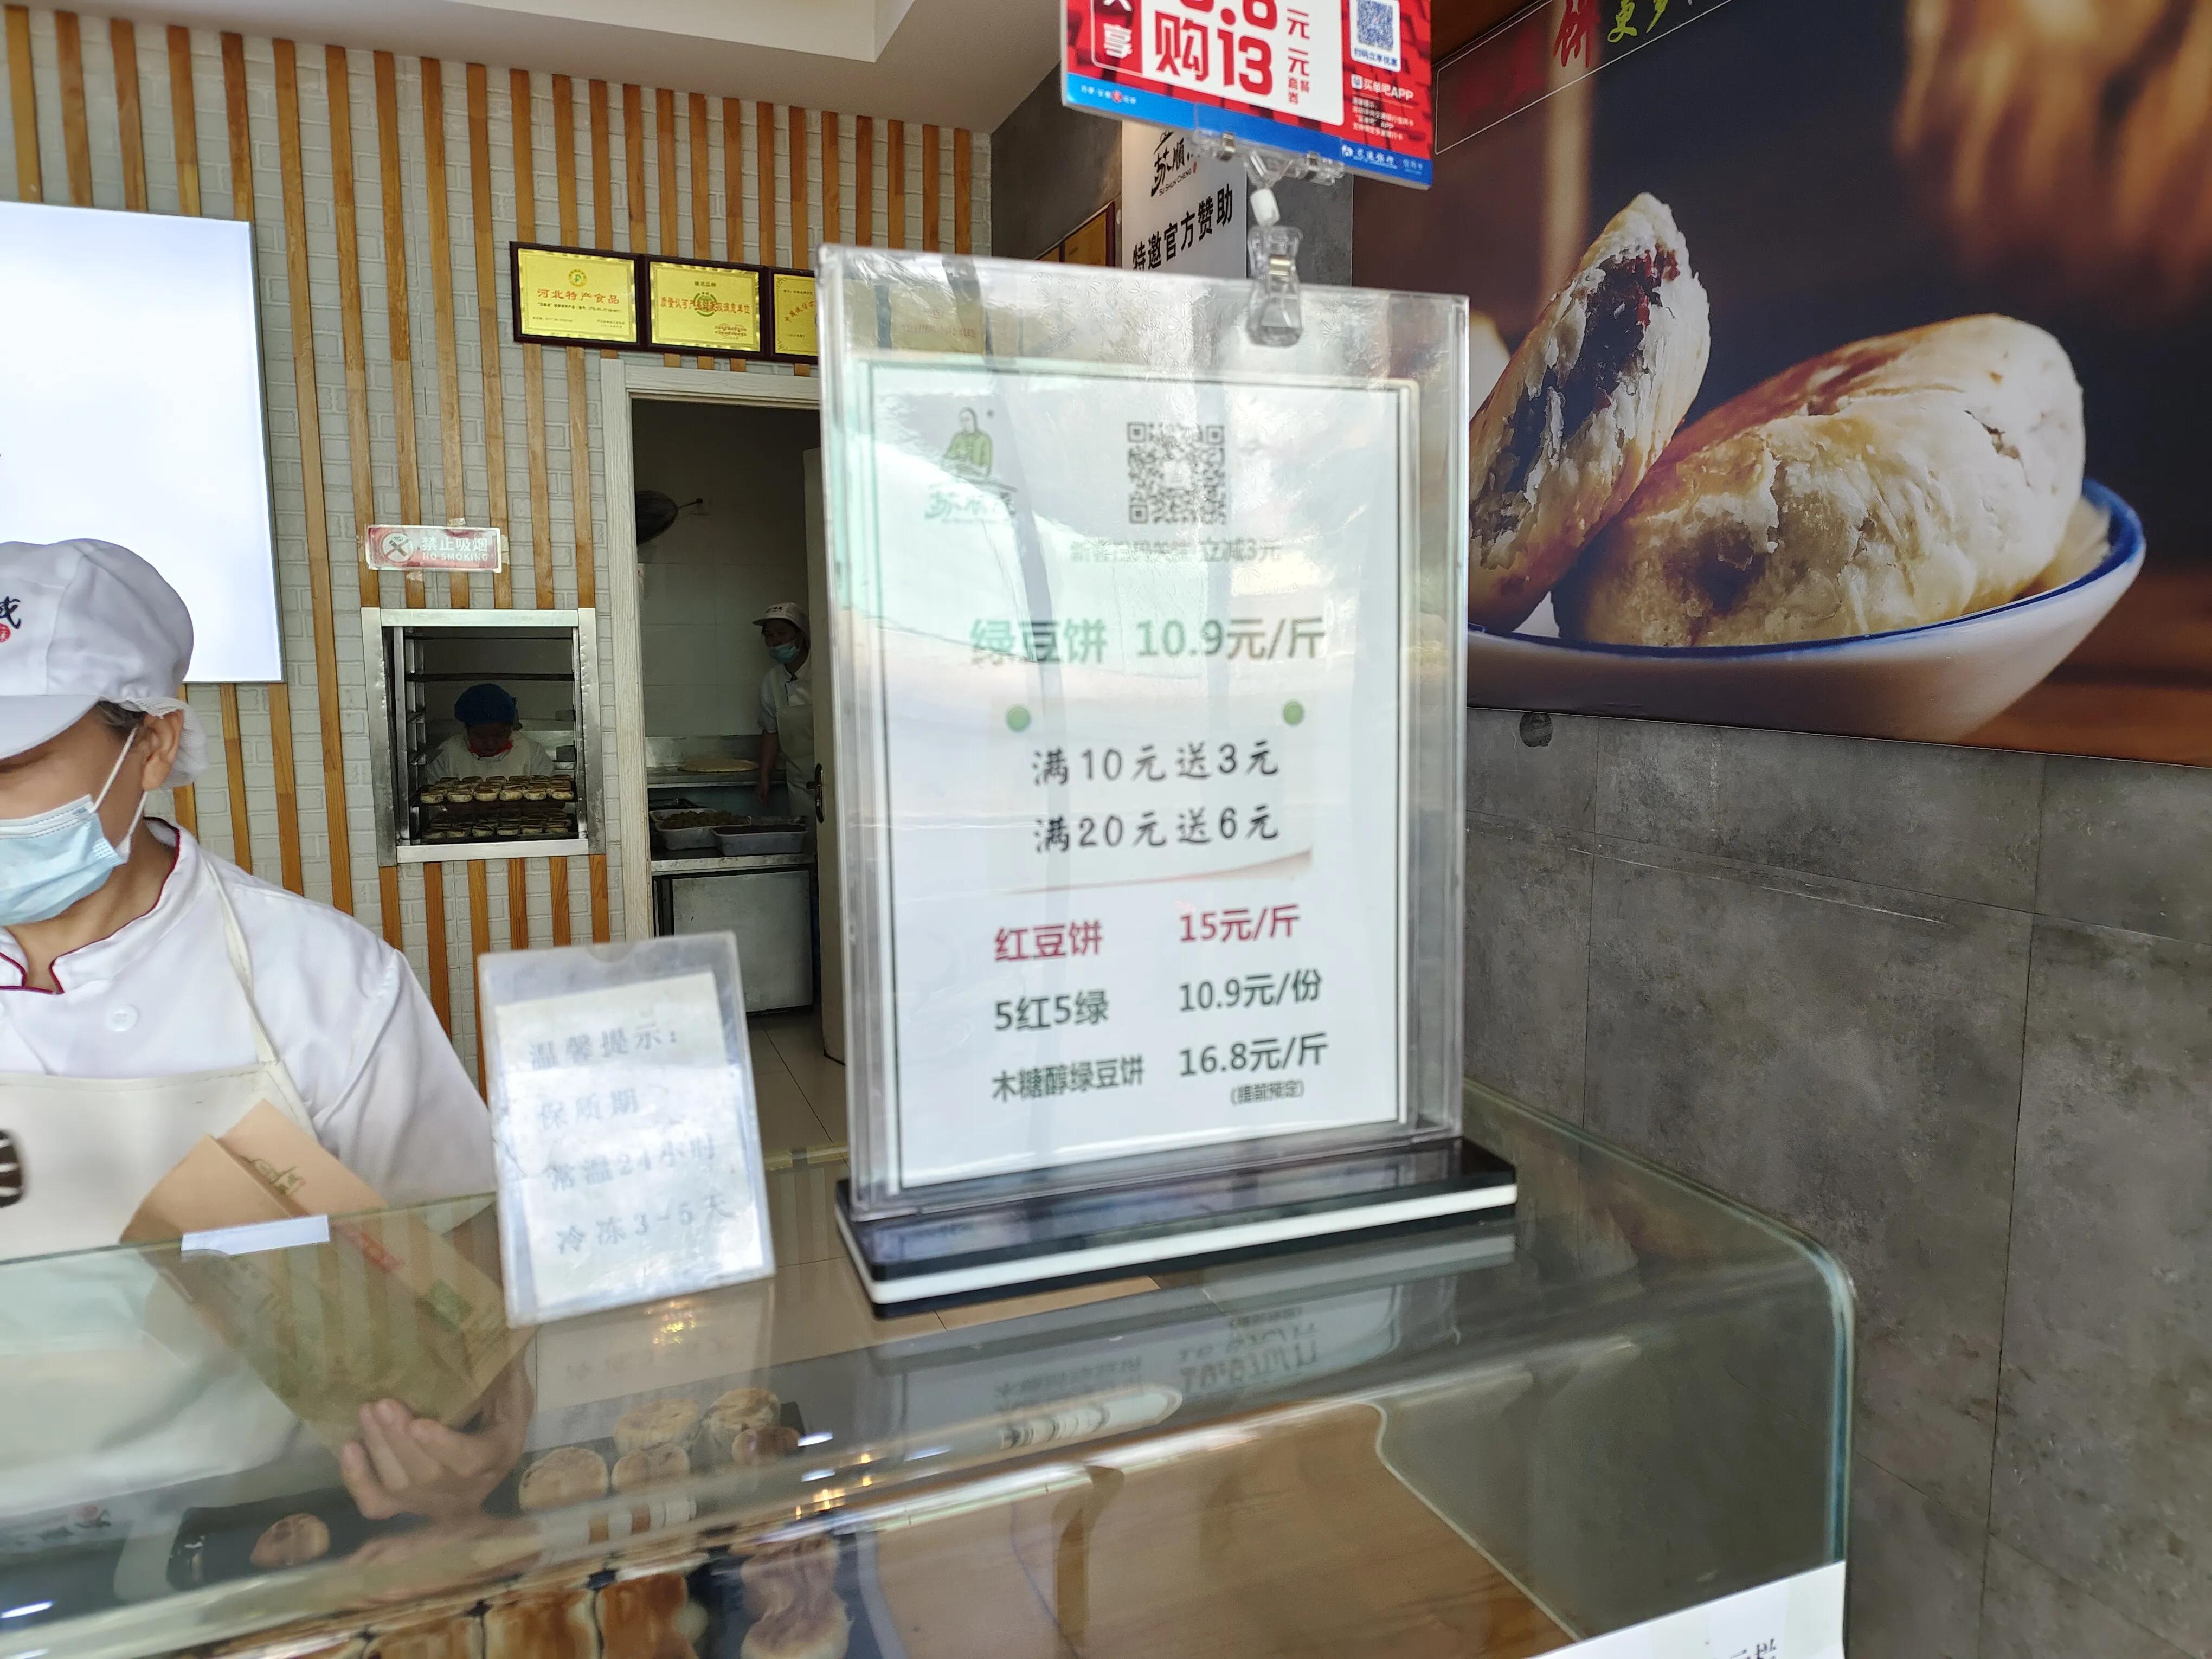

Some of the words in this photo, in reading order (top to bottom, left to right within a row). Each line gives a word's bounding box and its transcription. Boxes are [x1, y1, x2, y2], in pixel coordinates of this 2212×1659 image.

[1363, 78, 1414, 101] 买单吧APP
[1133, 183, 1233, 271] 特邀官方赞助
[537, 288, 620, 305] 河北特产食品
[422, 536, 488, 552] 禁止吸烟
[422, 552, 437, 560] NO
[440, 552, 488, 562] SMOKING
[969, 617, 1107, 668] 绿豆饼
[1137, 616, 1327, 661] 10.9元/斤
[1031, 739, 1279, 786] 满10元送3元
[1032, 804, 1279, 853] 满20元送6元
[994, 918, 1104, 962] 红豆饼
[1180, 903, 1301, 943] 15元/斤
[994, 988, 1110, 1032] 5红5绿
[1179, 967, 1323, 1012] 10.9元/份
[991, 1054, 1144, 1103] 木糖醇绿豆饼
[1179, 1031, 1328, 1077] 16.8元/斤
